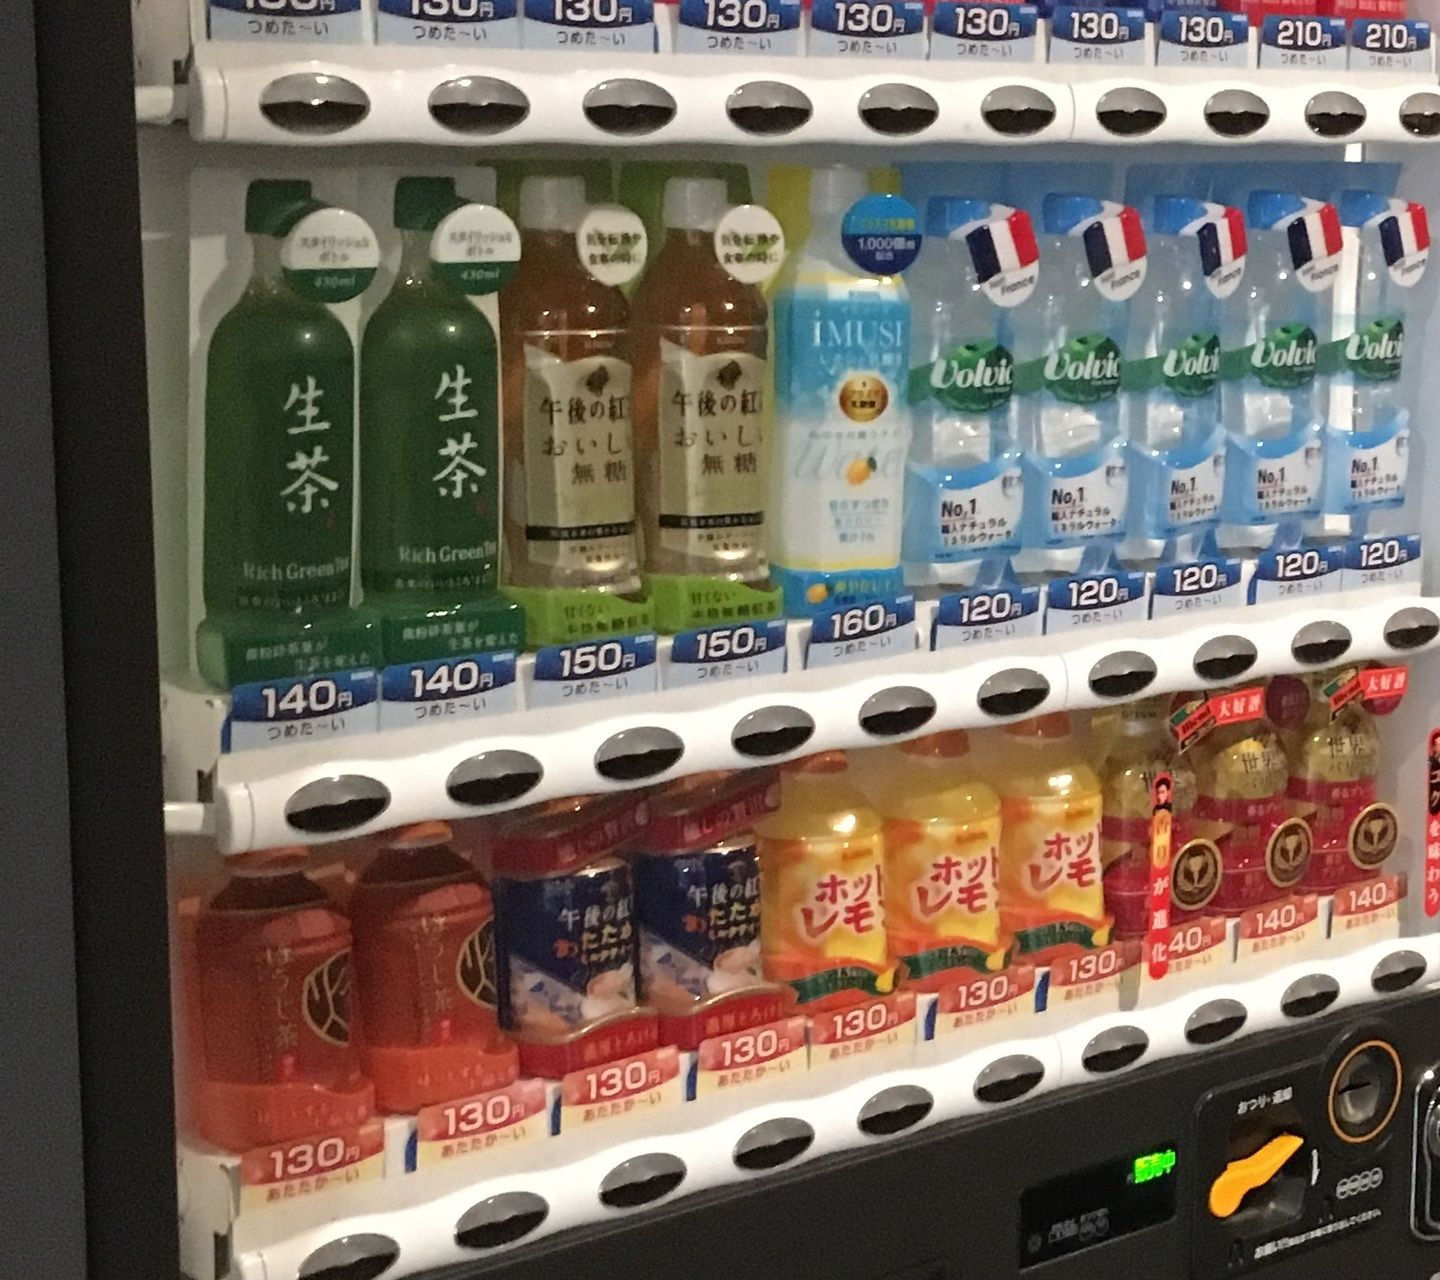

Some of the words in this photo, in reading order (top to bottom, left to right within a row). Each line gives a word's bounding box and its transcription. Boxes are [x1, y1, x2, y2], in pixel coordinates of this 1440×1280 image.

[835, 1, 906, 33] 130円
[955, 7, 1020, 37] 130円
[1071, 12, 1130, 40] 130円
[1179, 15, 1234, 44] 130円
[1277, 21, 1332, 47] 210円
[1366, 24, 1417, 49] 210円
[280, 374, 339, 515] 生茶
[433, 364, 487, 499] 生茶
[571, 460, 627, 485] 無糖
[702, 452, 757, 475] 無糖
[400, 545, 436, 562] Rich
[439, 545, 484, 562] Green
[1276, 551, 1328, 578] 120円
[1360, 540, 1407, 567] 120円
[1069, 578, 1129, 608] 120円
[1173, 564, 1227, 593] 120円
[831, 604, 897, 639] 160円
[960, 593, 1022, 624] 120円
[697, 627, 767, 659] 150円
[560, 643, 636, 678] 150円
[411, 661, 494, 698] 140円
[262, 679, 353, 718] 140円
[1169, 927, 1211, 954] 40円
[722, 1030, 790, 1067] 130円
[586, 1061, 660, 1100] 130円
[443, 1094, 525, 1135] 130円
[270, 1137, 360, 1179] 130円
